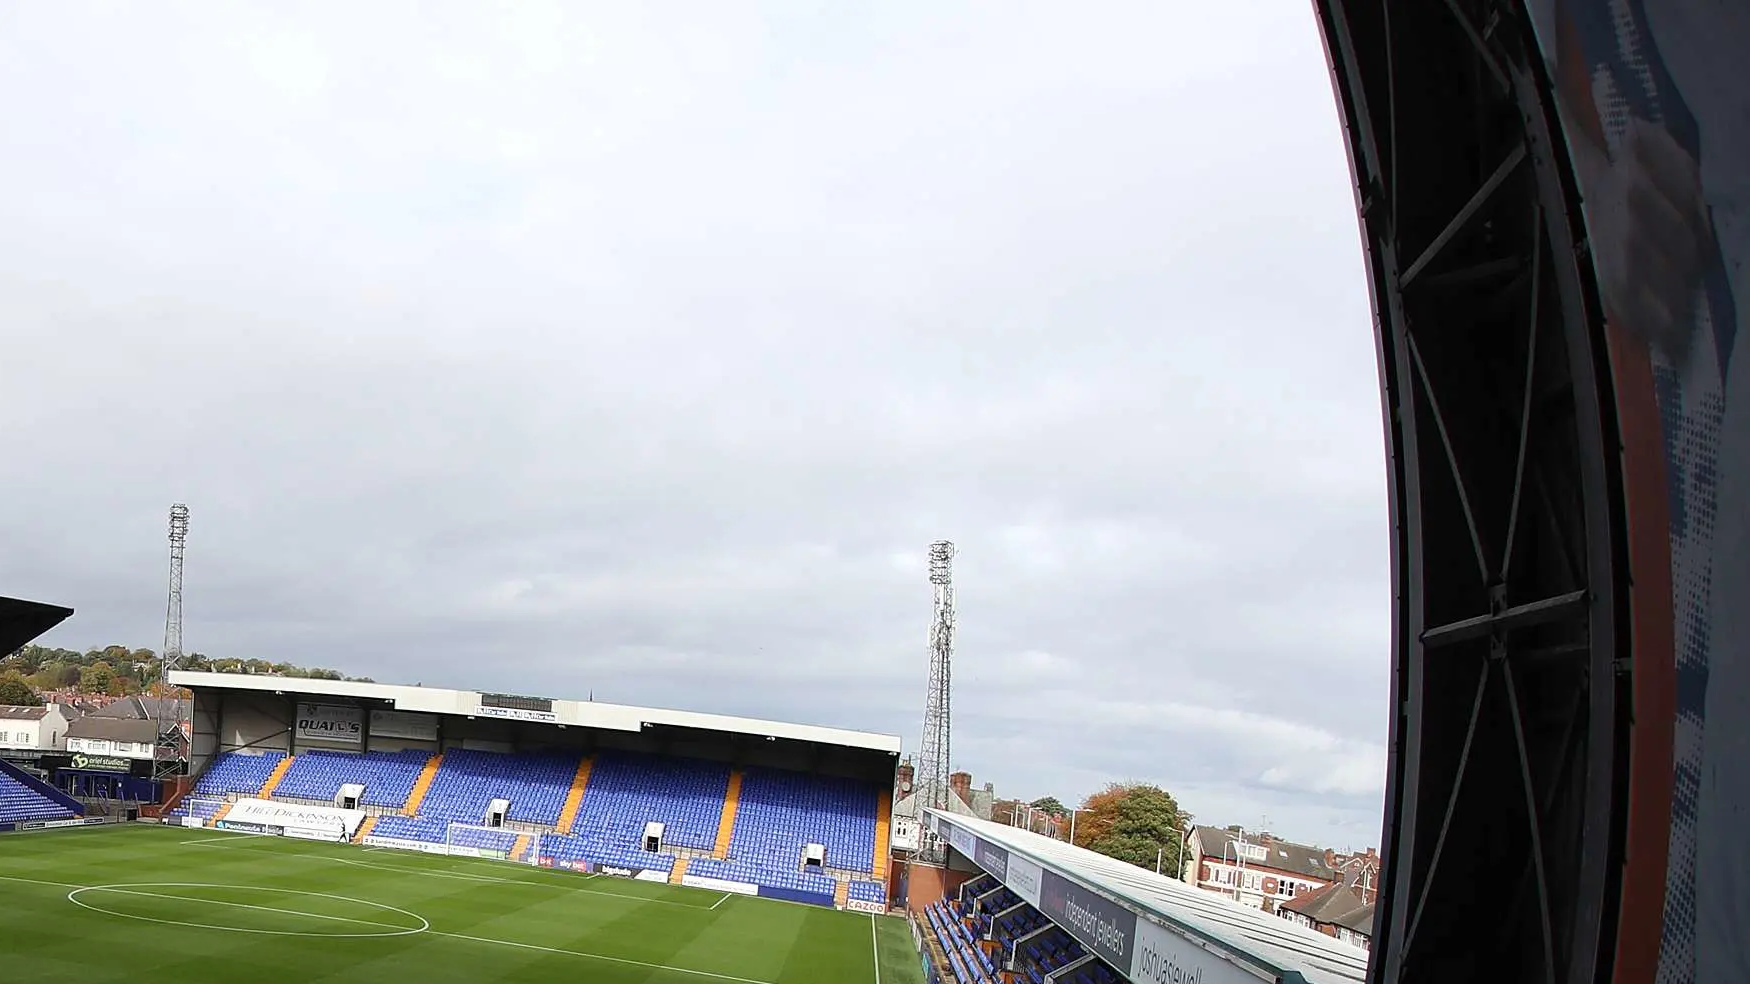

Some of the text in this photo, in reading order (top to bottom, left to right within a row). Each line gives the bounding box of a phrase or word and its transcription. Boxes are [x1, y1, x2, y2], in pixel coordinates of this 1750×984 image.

[848, 900, 884, 913] CAZOO
[1065, 892, 1098, 938] independent
[1094, 912, 1125, 956] jewellers
